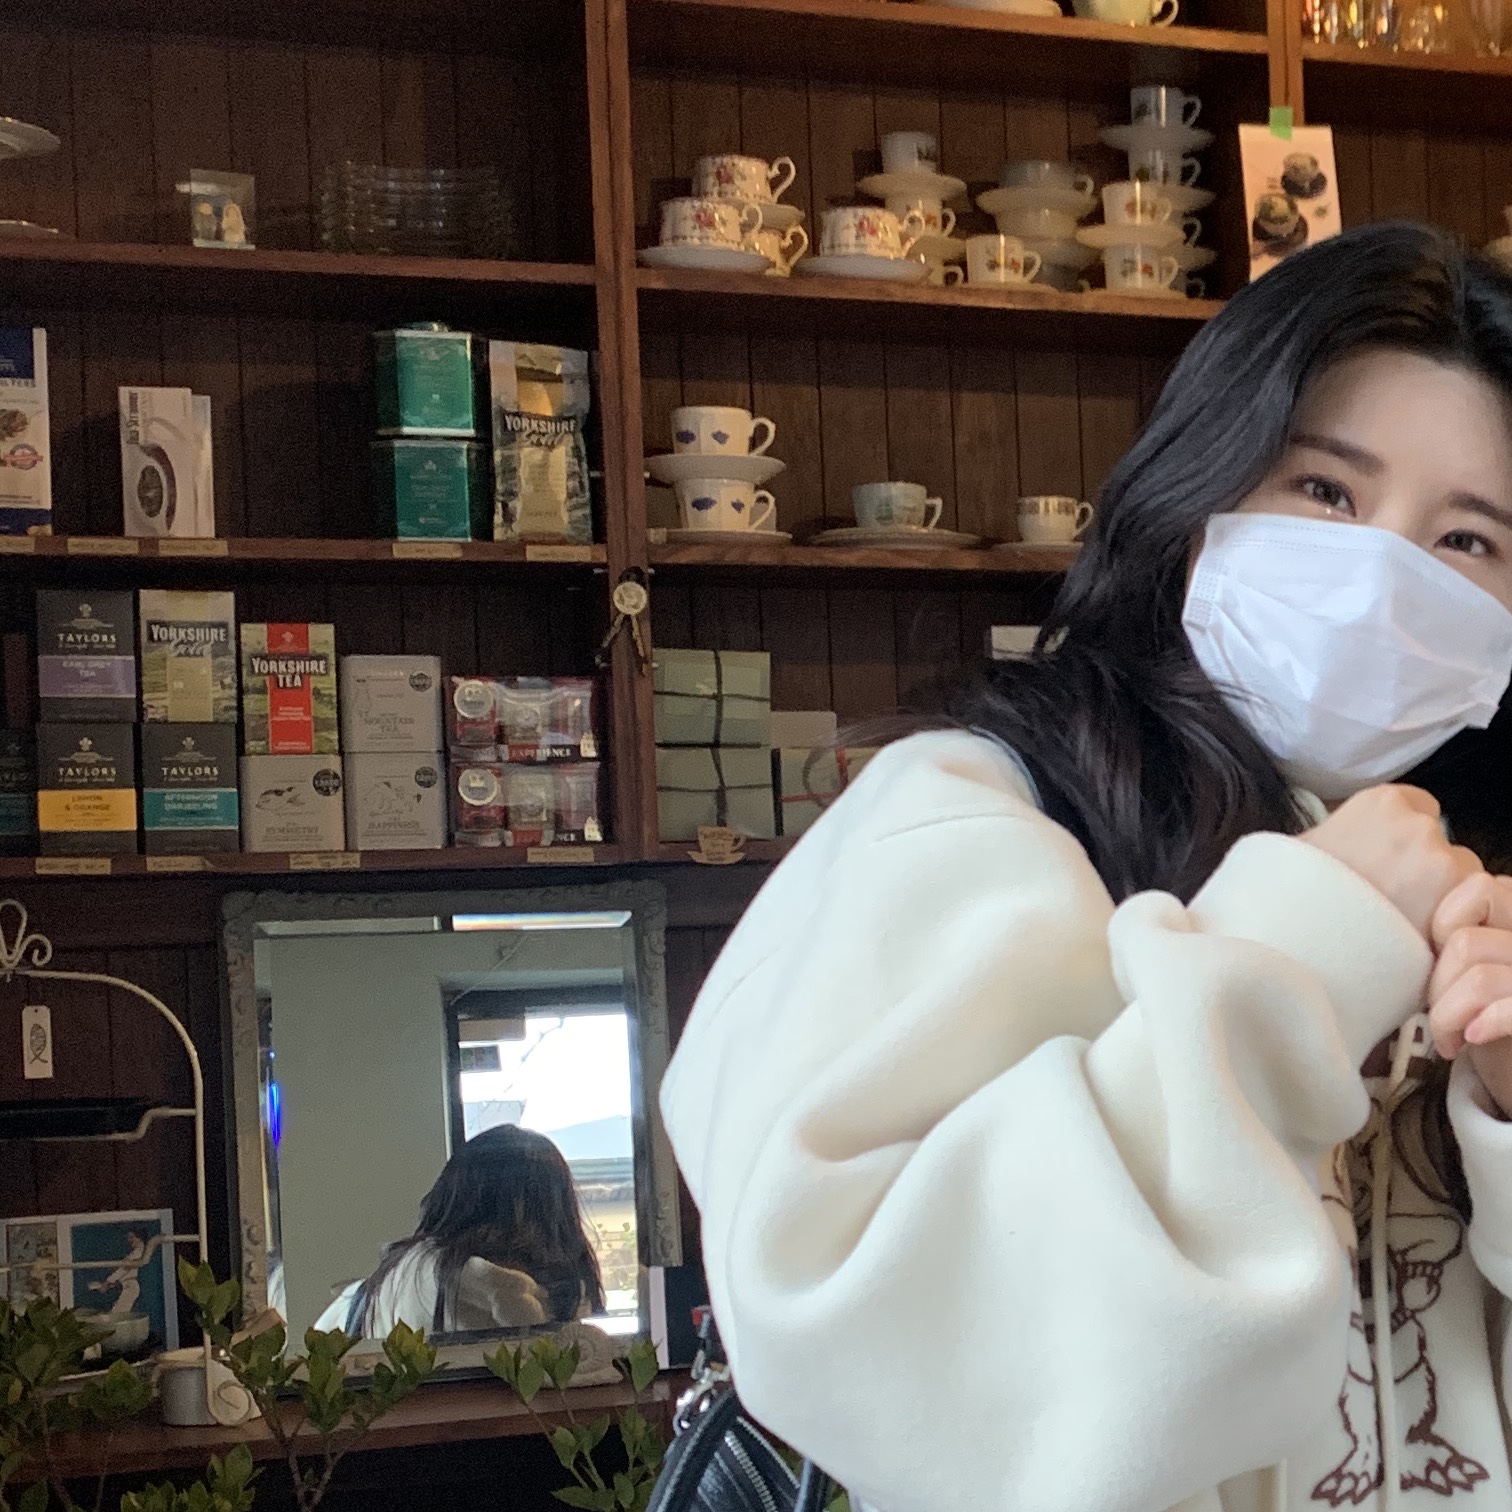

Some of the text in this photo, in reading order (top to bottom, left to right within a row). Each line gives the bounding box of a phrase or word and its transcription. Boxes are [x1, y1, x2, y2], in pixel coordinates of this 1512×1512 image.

[504, 414, 578, 434] YORKSHIRE
[57, 633, 117, 643] TAYLORS
[150, 623, 228, 642] YORKSHIRE
[251, 657, 328, 674] YORKSHIRE
[276, 673, 303, 688] TEA
[58, 766, 117, 777] TAYLORS
[161, 766, 219, 777] TAYLORS
